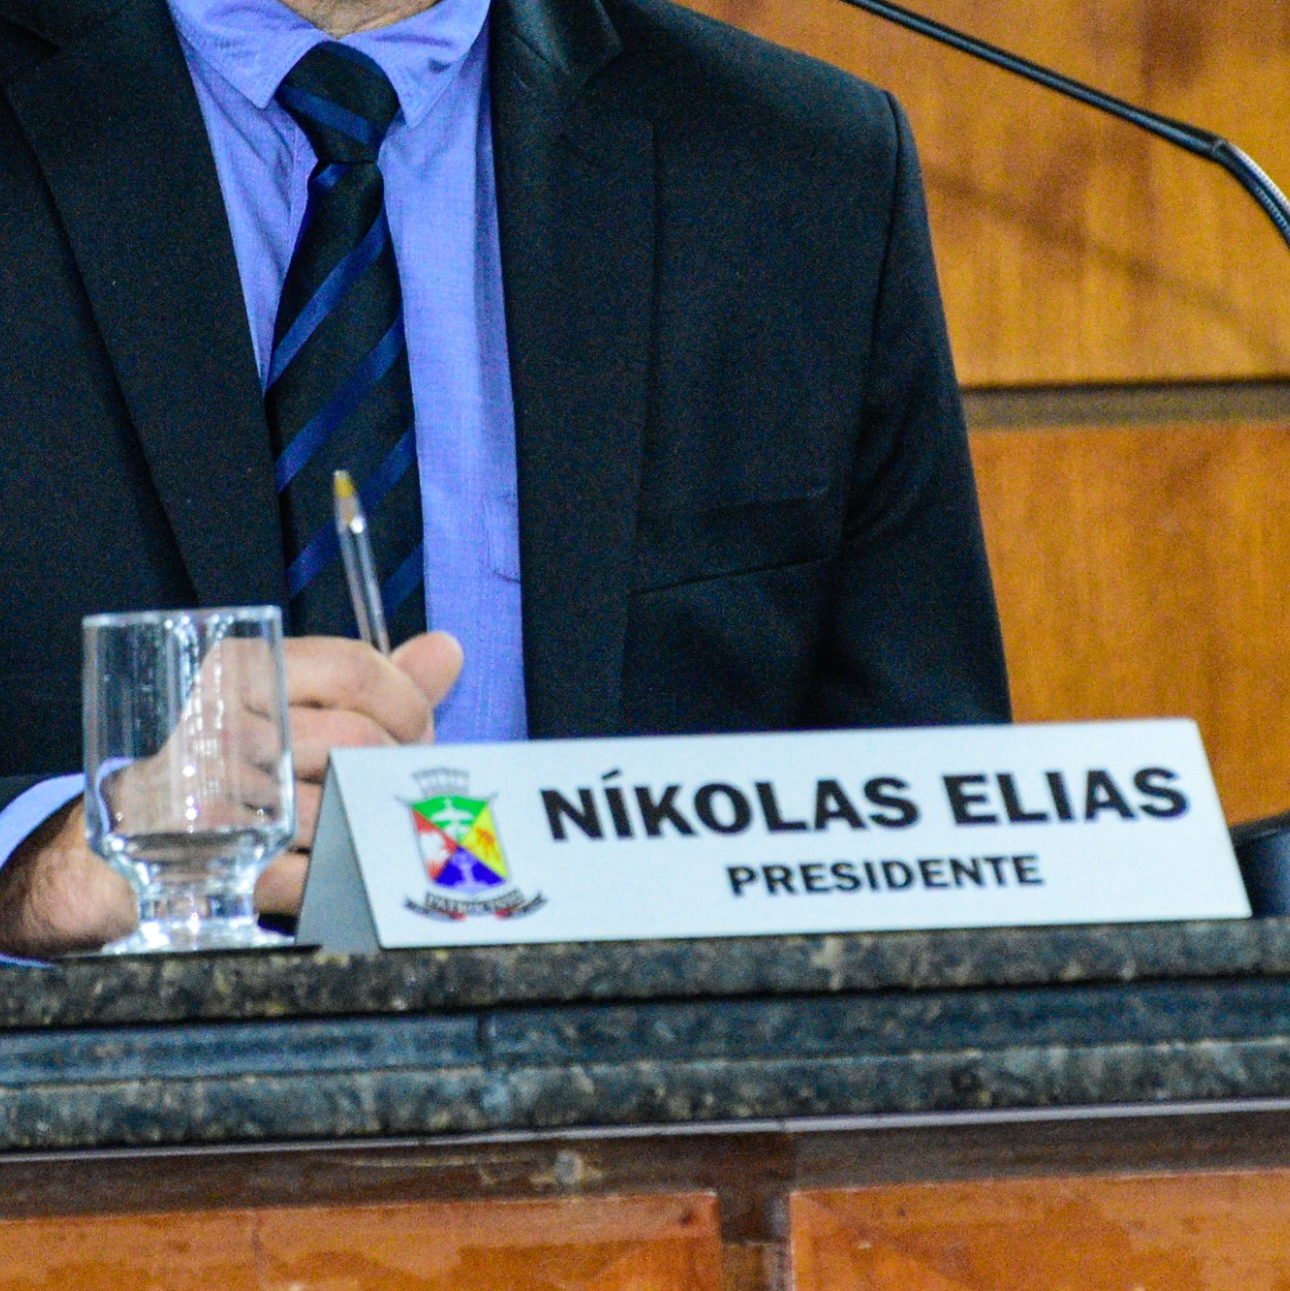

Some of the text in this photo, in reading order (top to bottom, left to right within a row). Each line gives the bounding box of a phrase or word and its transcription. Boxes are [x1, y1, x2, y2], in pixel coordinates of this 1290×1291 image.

[539, 766, 1189, 842] NÍKOLAS ELIAS
[726, 854, 1044, 897] PRESIDENTE
